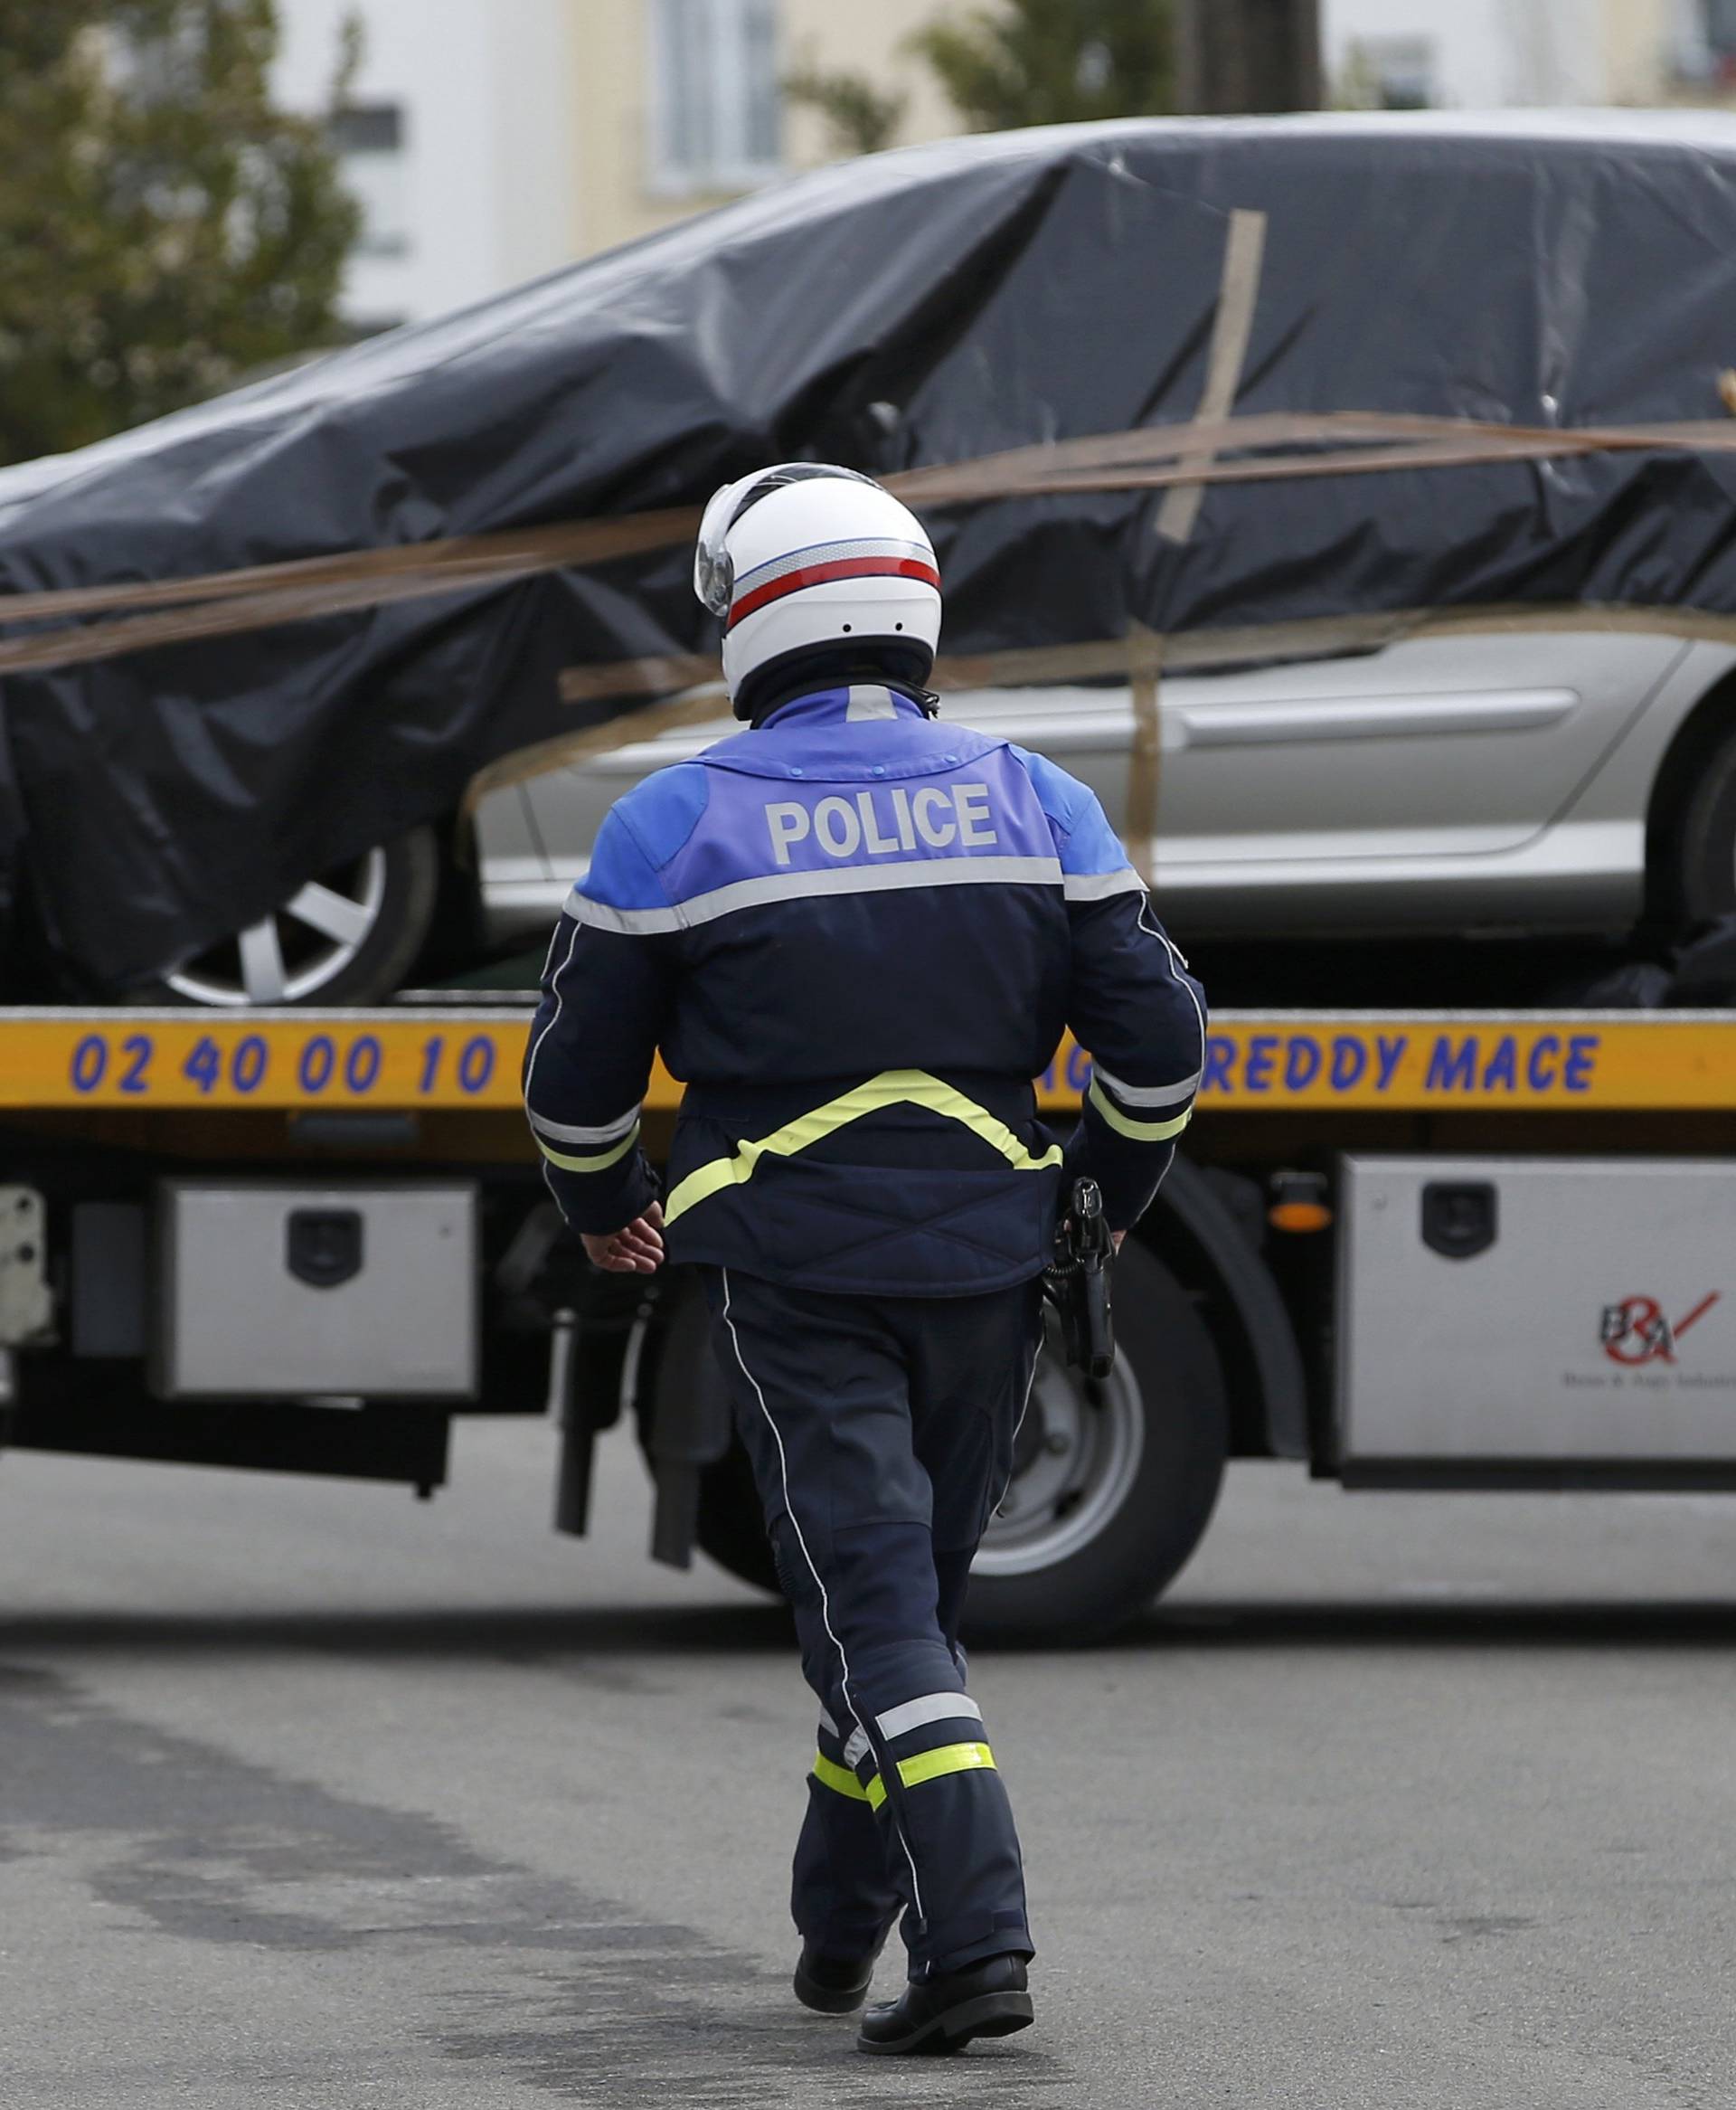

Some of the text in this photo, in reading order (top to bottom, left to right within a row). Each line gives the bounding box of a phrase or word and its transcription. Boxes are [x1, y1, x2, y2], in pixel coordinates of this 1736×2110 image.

[765, 783, 998, 866] POLICE
[71, 1035, 495, 1093] 02 40 00 10
[1202, 1036, 1599, 1092] REDDY MACE
